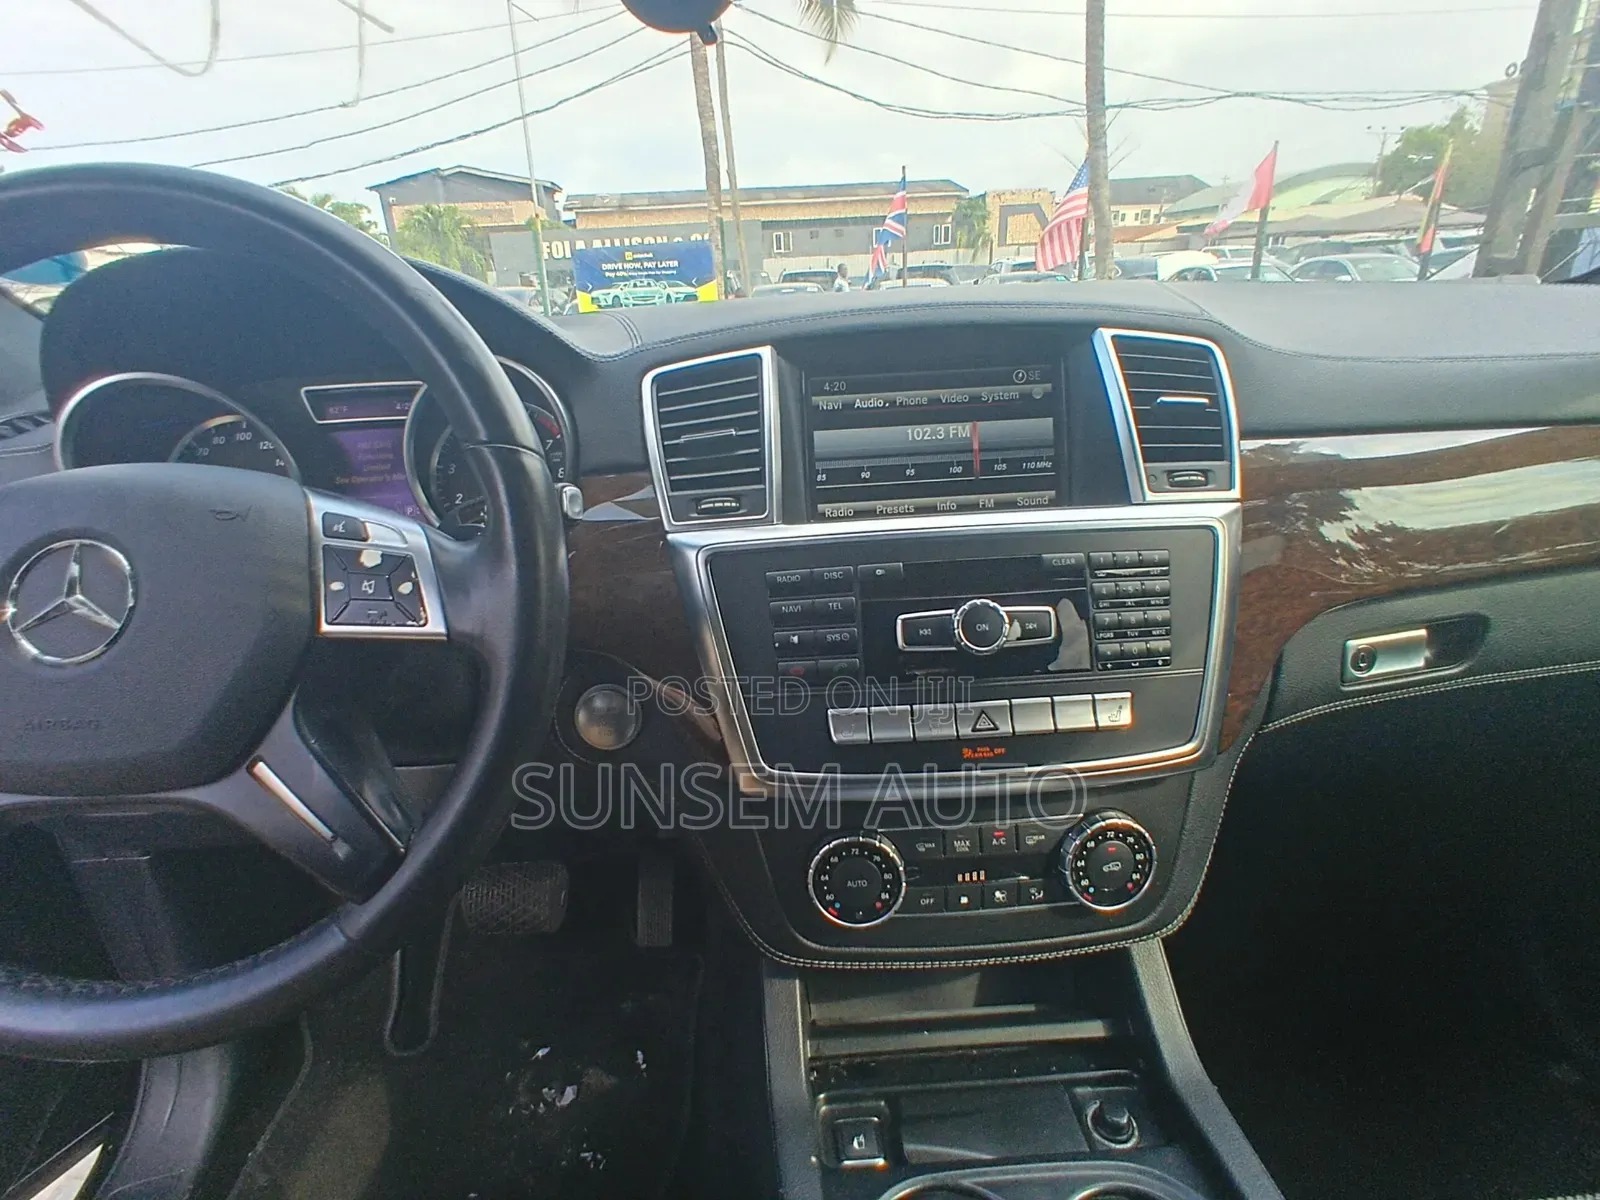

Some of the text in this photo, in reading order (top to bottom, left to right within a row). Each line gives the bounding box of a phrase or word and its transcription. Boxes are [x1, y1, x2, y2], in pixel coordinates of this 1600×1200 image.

[644, 261, 657, 269] PAY
[658, 260, 679, 268] LATER
[1028, 370, 1041, 380] SE
[823, 381, 846, 392] 4:20
[940, 392, 969, 404] Video
[981, 389, 1019, 403] System
[819, 400, 842, 411] Navi
[854, 397, 884, 409] Audio
[896, 395, 928, 407] Phone
[236, 432, 252, 441] 100
[906, 425, 970, 441] 102.3 FM
[545, 439, 553, 450] 7
[993, 463, 1007, 471] 105
[1022, 460, 1053, 469] 110 MHz
[905, 468, 916, 477] 95
[949, 465, 963, 474] 100
[816, 474, 827, 482] 85
[860, 471, 871, 479] 90
[454, 493, 463, 504] 2
[1017, 496, 1049, 506] Sound
[937, 501, 957, 511] Info
[979, 499, 995, 508] FM
[825, 507, 854, 518] Radio
[876, 504, 915, 515] Presets
[1052, 557, 1076, 567] CLEAR
[776, 575, 801, 584] RADIO
[824, 571, 844, 580] DISC
[781, 605, 802, 614] NAVI
[828, 602, 843, 610] TEL
[975, 623, 989, 632] ON
[826, 633, 841, 642] SYS
[953, 839, 971, 847] MAX
[992, 837, 1007, 846] A/C
[1131, 872, 1140, 880] 84
[847, 880, 868, 888] AUTO
[1080, 878, 1089, 886] 60
[825, 893, 835, 901] 60
[881, 892, 890, 900] 84
